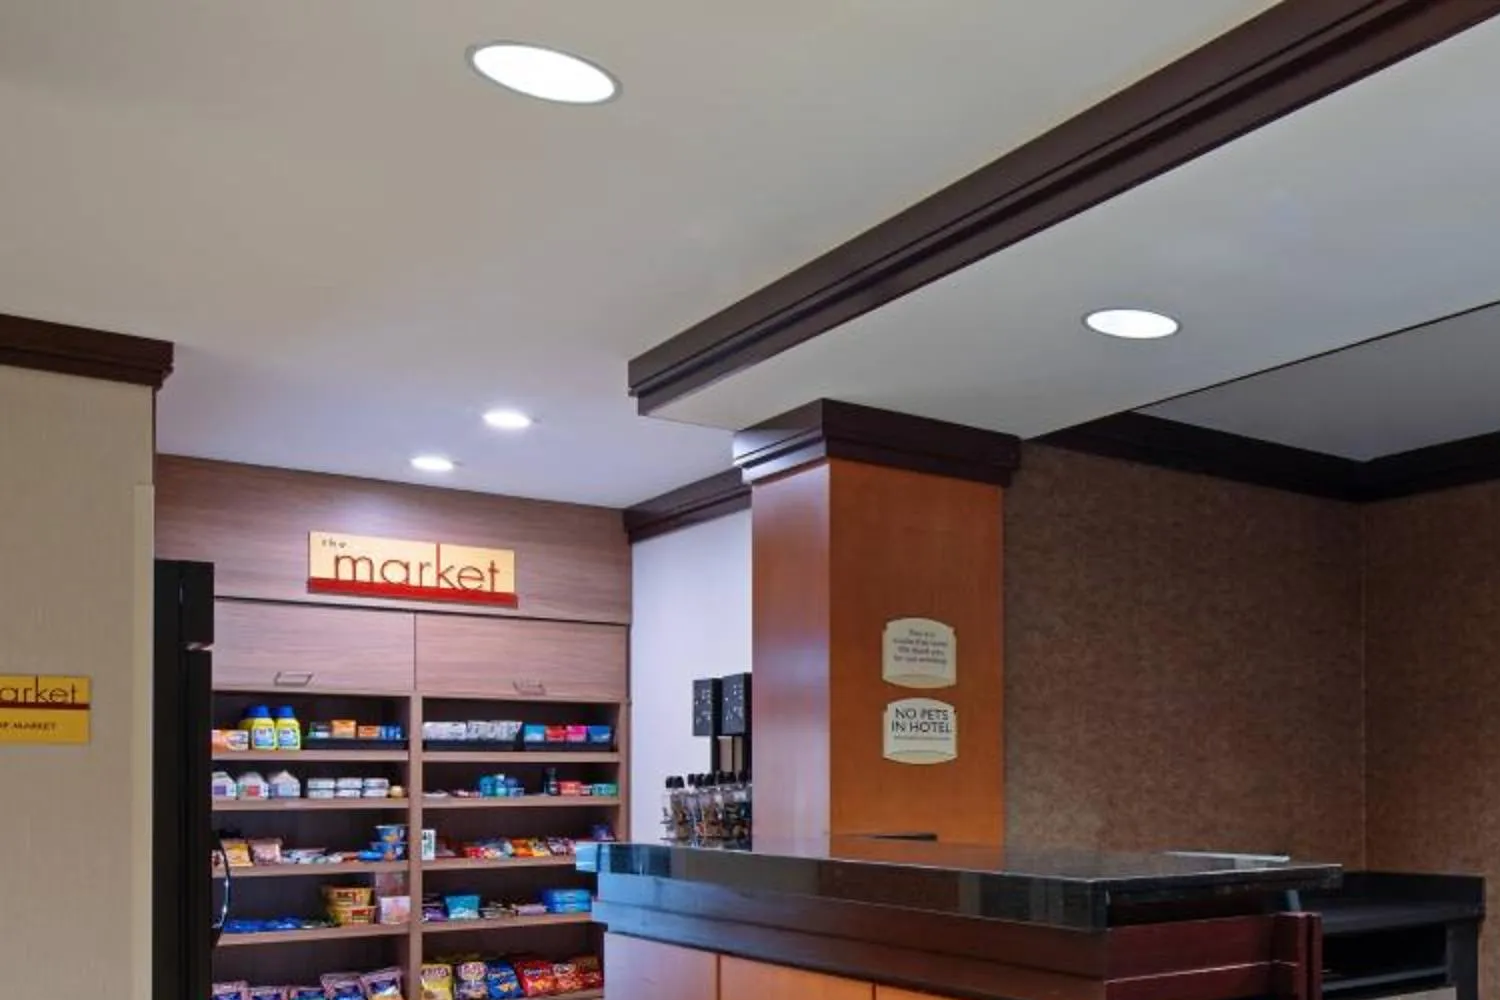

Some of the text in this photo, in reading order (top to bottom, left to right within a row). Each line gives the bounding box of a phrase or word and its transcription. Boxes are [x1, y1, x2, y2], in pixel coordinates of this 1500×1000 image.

[321, 538, 347, 549] the
[334, 541, 500, 592] market
[0, 675, 77, 704] arket
[895, 707, 949, 721] NO PETS
[892, 720, 952, 733] IN HOTEL
